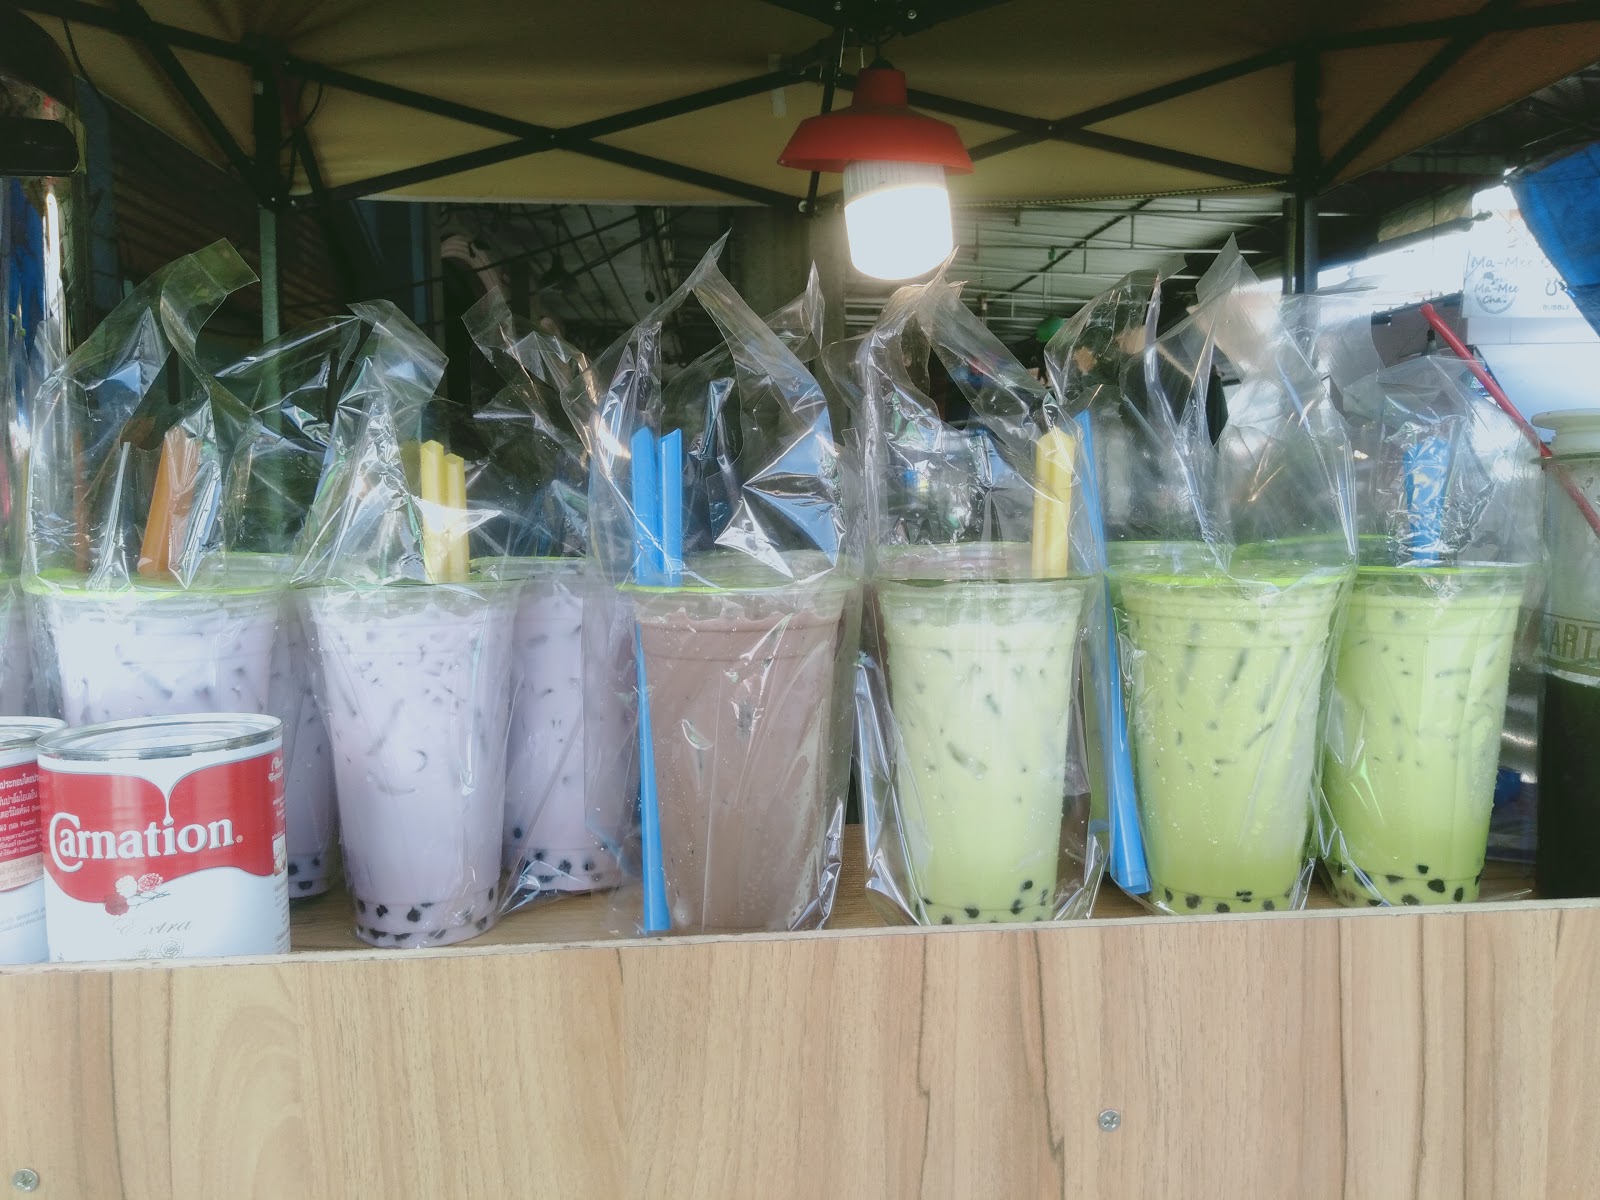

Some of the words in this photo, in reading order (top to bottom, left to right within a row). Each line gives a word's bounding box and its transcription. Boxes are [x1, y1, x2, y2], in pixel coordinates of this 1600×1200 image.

[1473, 283, 1520, 294] Ma-Mee
[50, 812, 234, 873] Carnation
[115, 918, 193, 937] Extra
